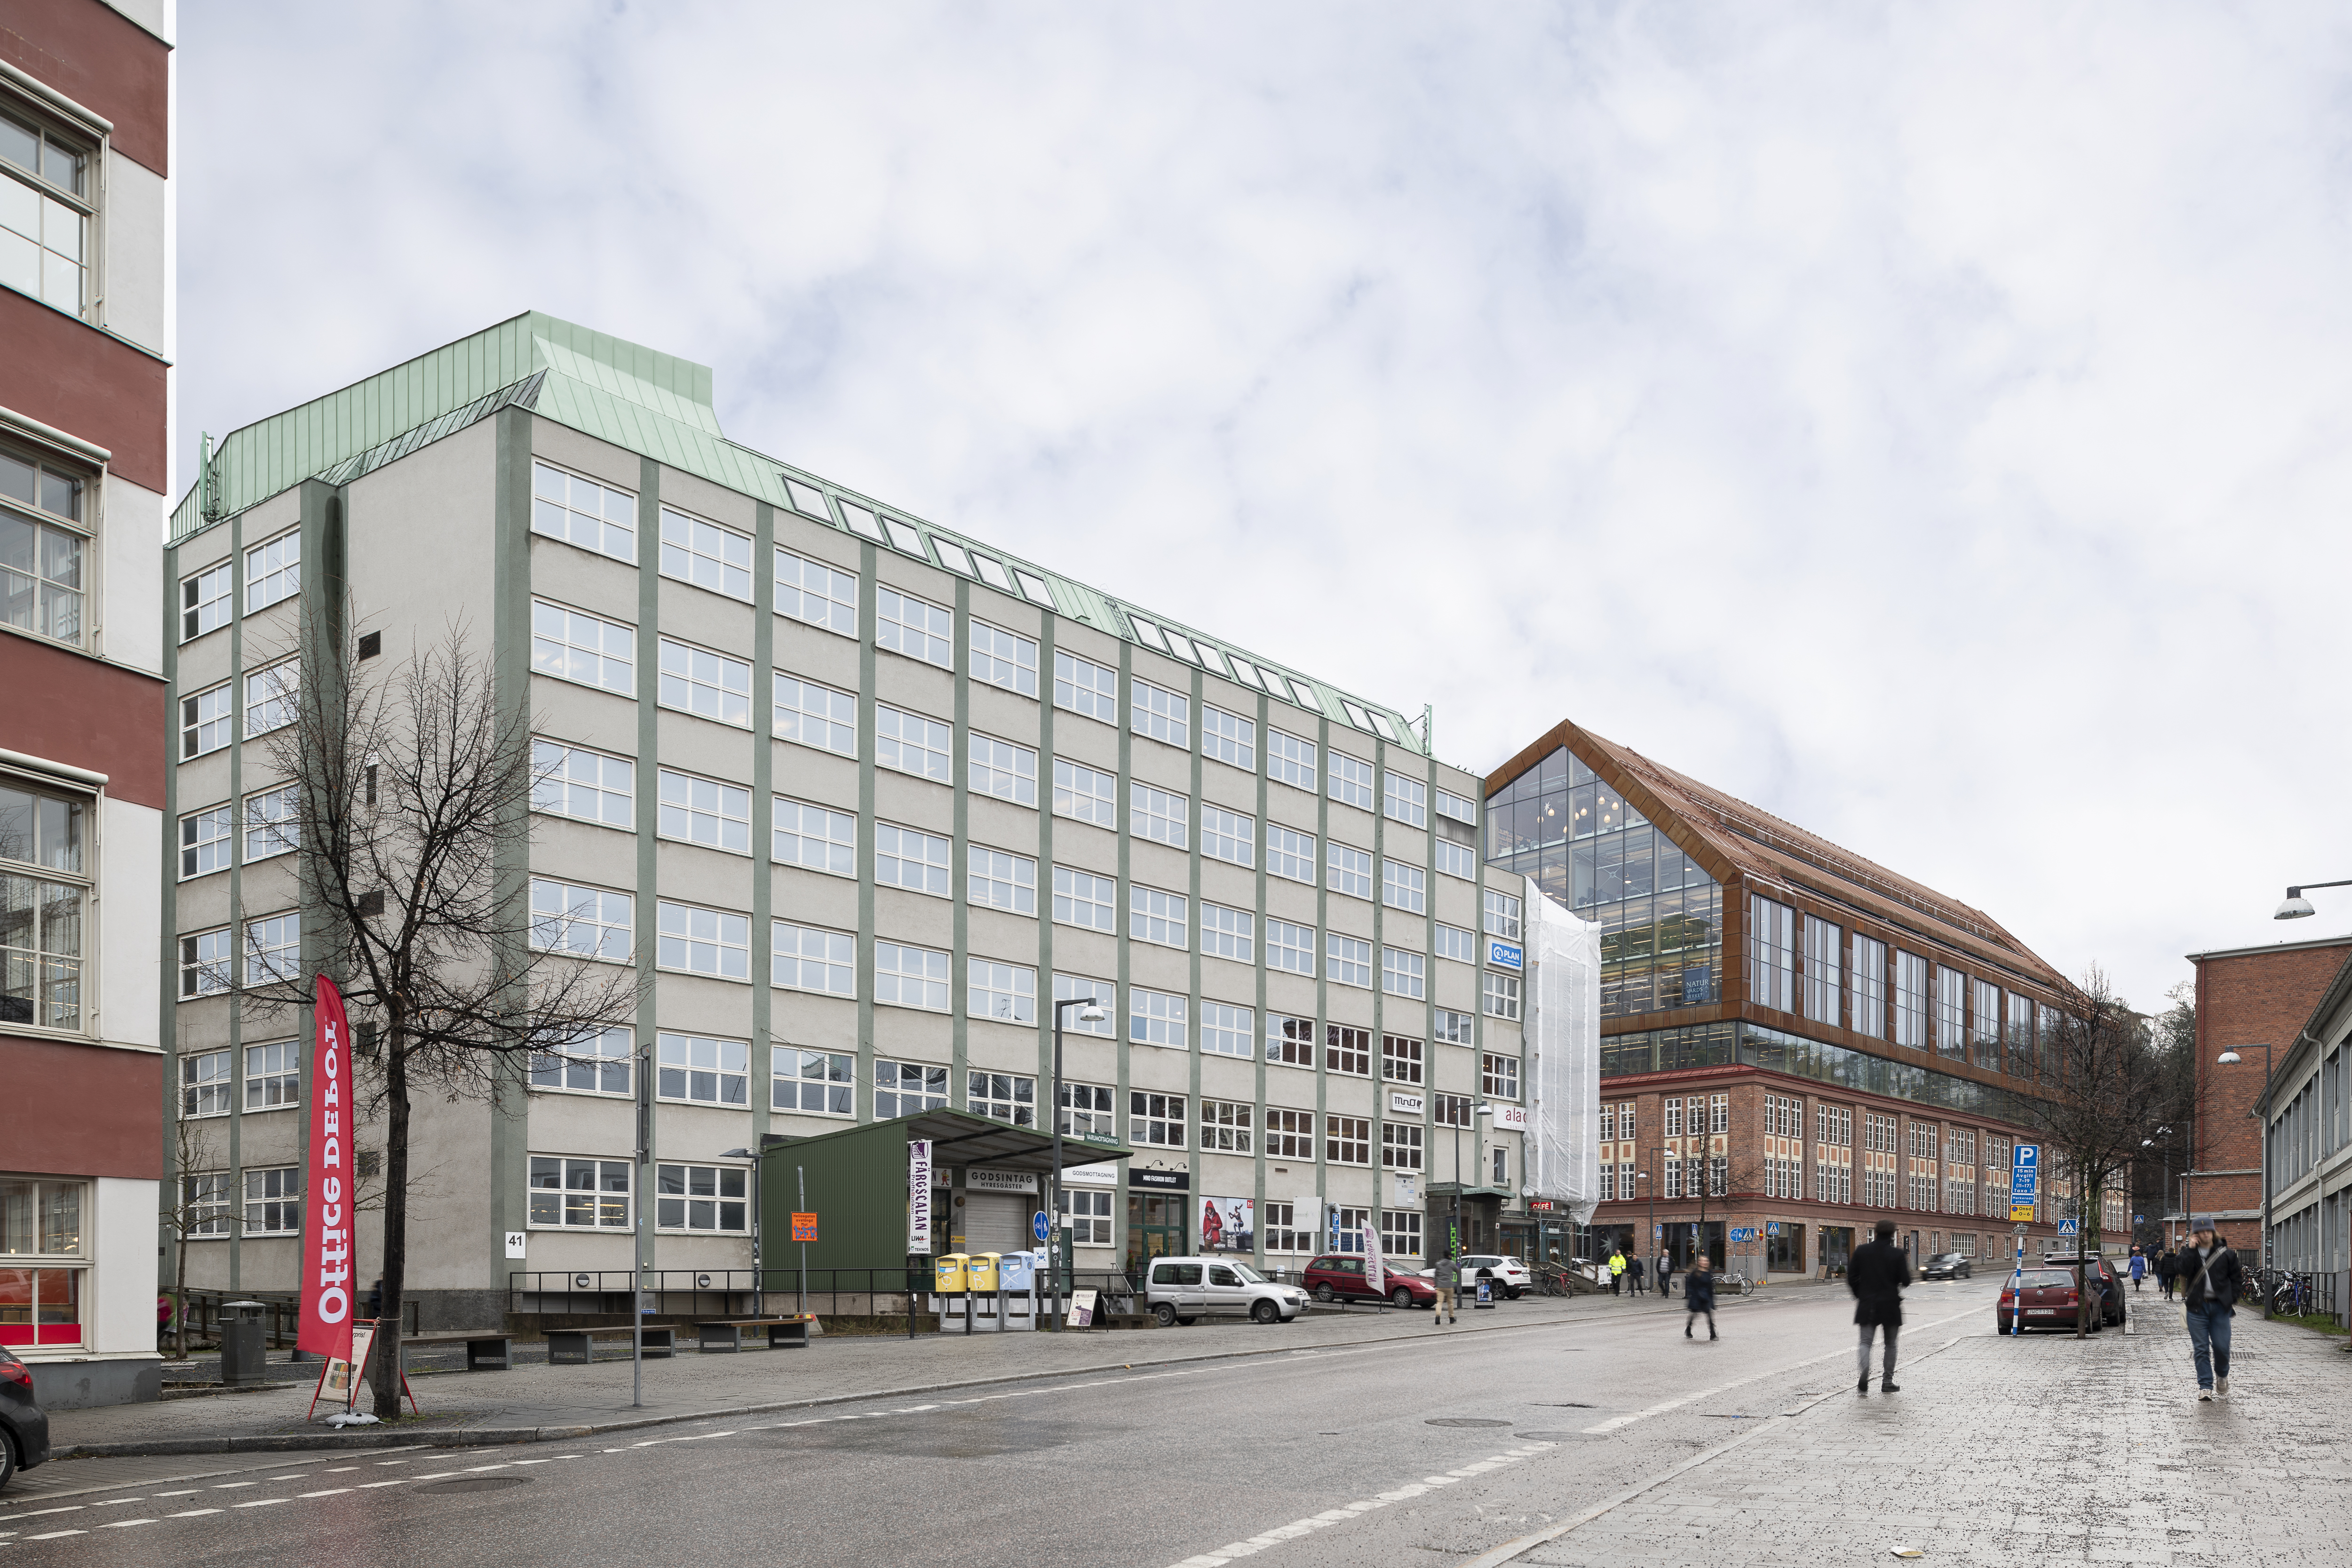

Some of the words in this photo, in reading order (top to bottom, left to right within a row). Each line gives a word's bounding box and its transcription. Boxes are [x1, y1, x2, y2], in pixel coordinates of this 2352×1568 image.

[1504, 949, 1519, 961] PLAN
[1686, 979, 1709, 988] NATUR
[1087, 1134, 1118, 1145] VARUMOTTAGNING
[2019, 1147, 2034, 1165] P
[971, 1172, 1033, 1183] GODSINTAG
[915, 1161, 930, 1230] FÄRGSCALAN
[1334, 1215, 1338, 1224] P
[509, 1235, 522, 1246] 41
